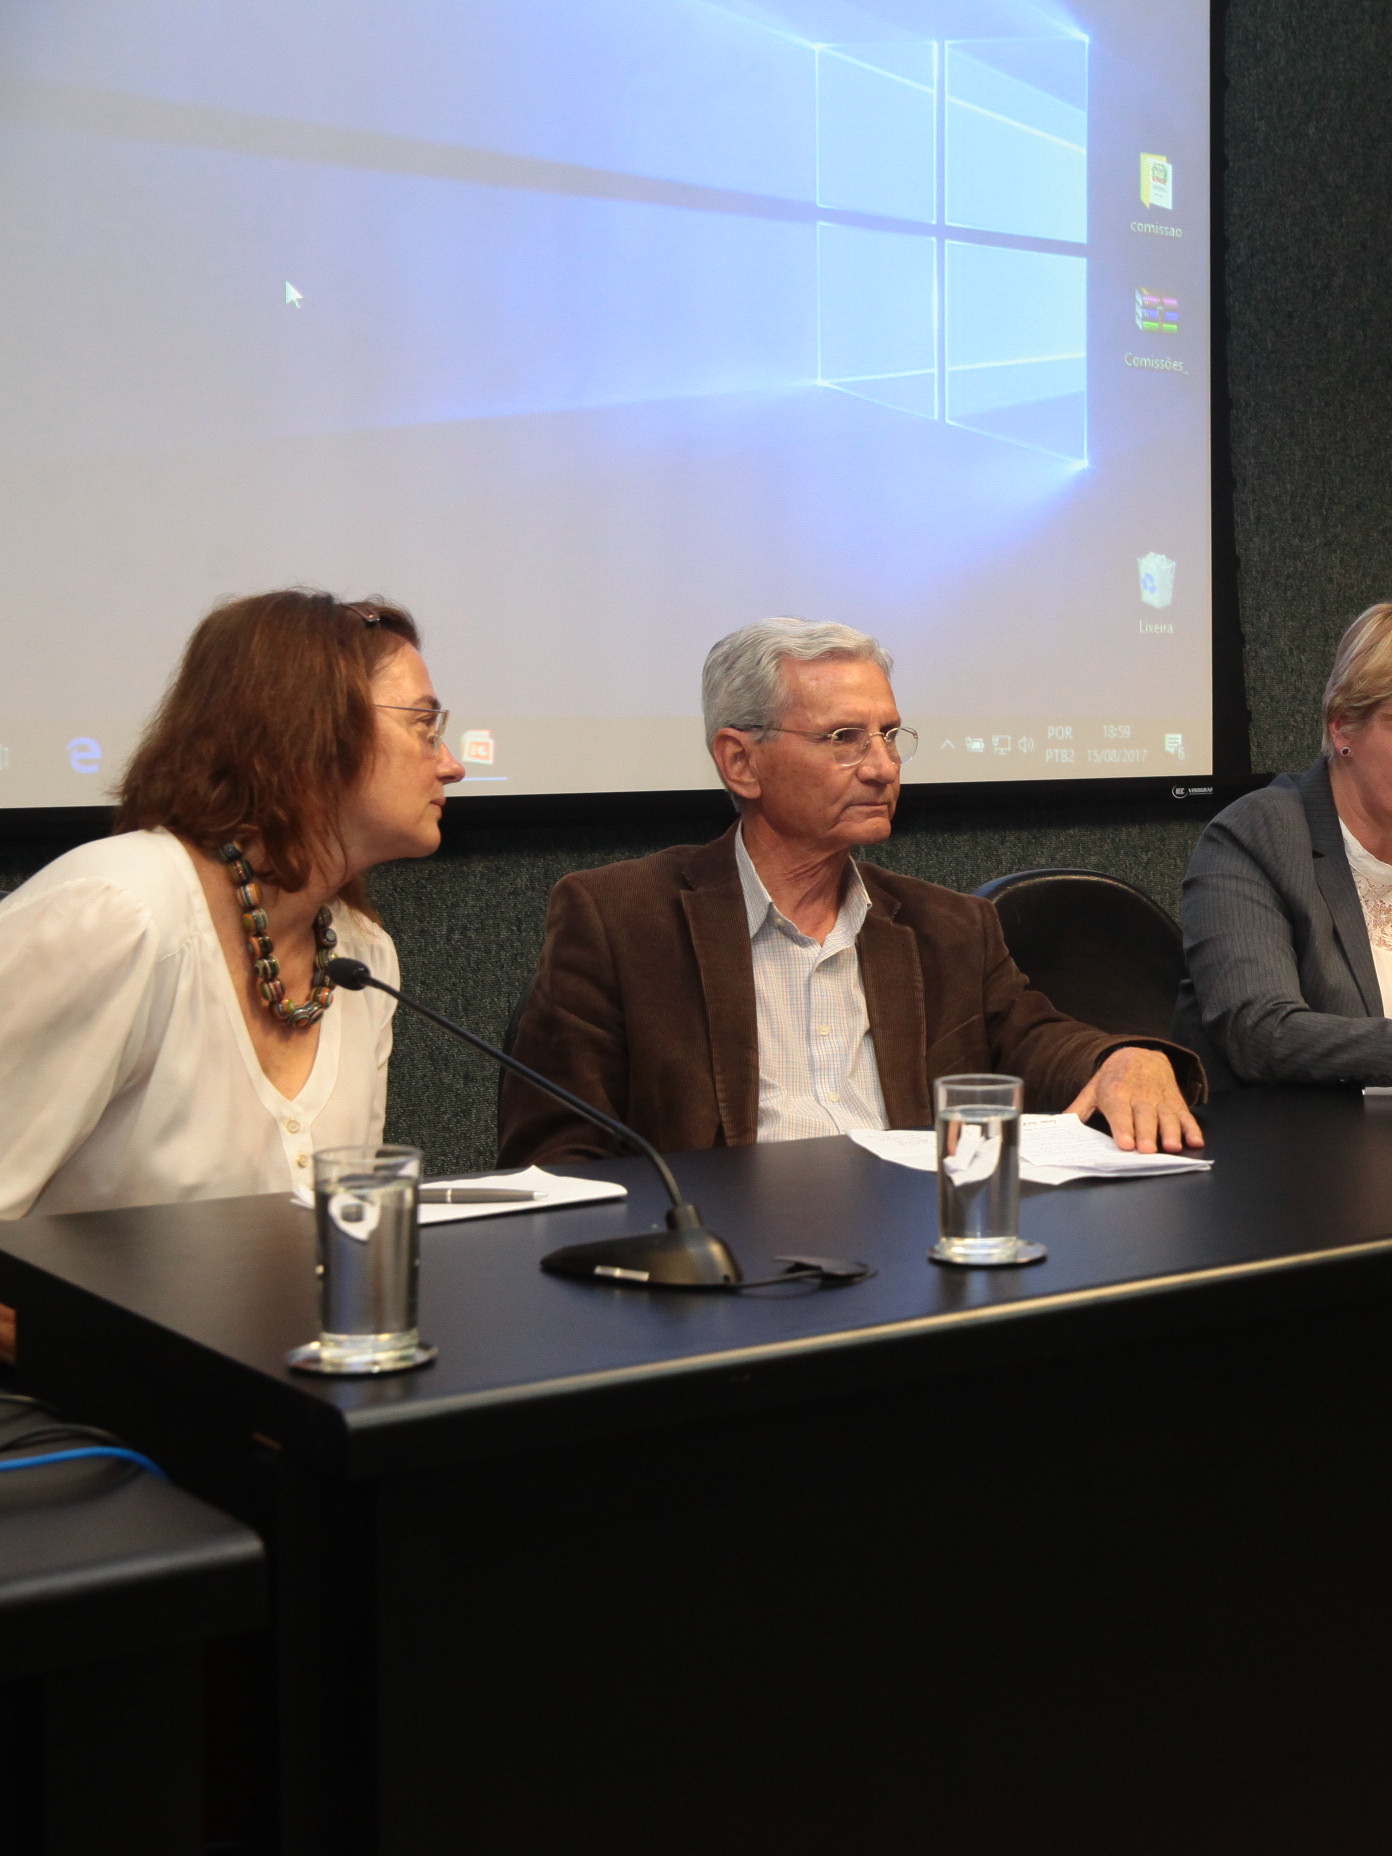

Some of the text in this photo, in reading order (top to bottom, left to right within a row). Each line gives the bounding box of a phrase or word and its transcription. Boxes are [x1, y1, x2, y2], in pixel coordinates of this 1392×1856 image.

[1130, 220, 1183, 238] comissao
[1139, 620, 1174, 635] Lixeira
[1047, 726, 1073, 739] POR
[1045, 748, 1148, 763] PTB2 15/08/2017
